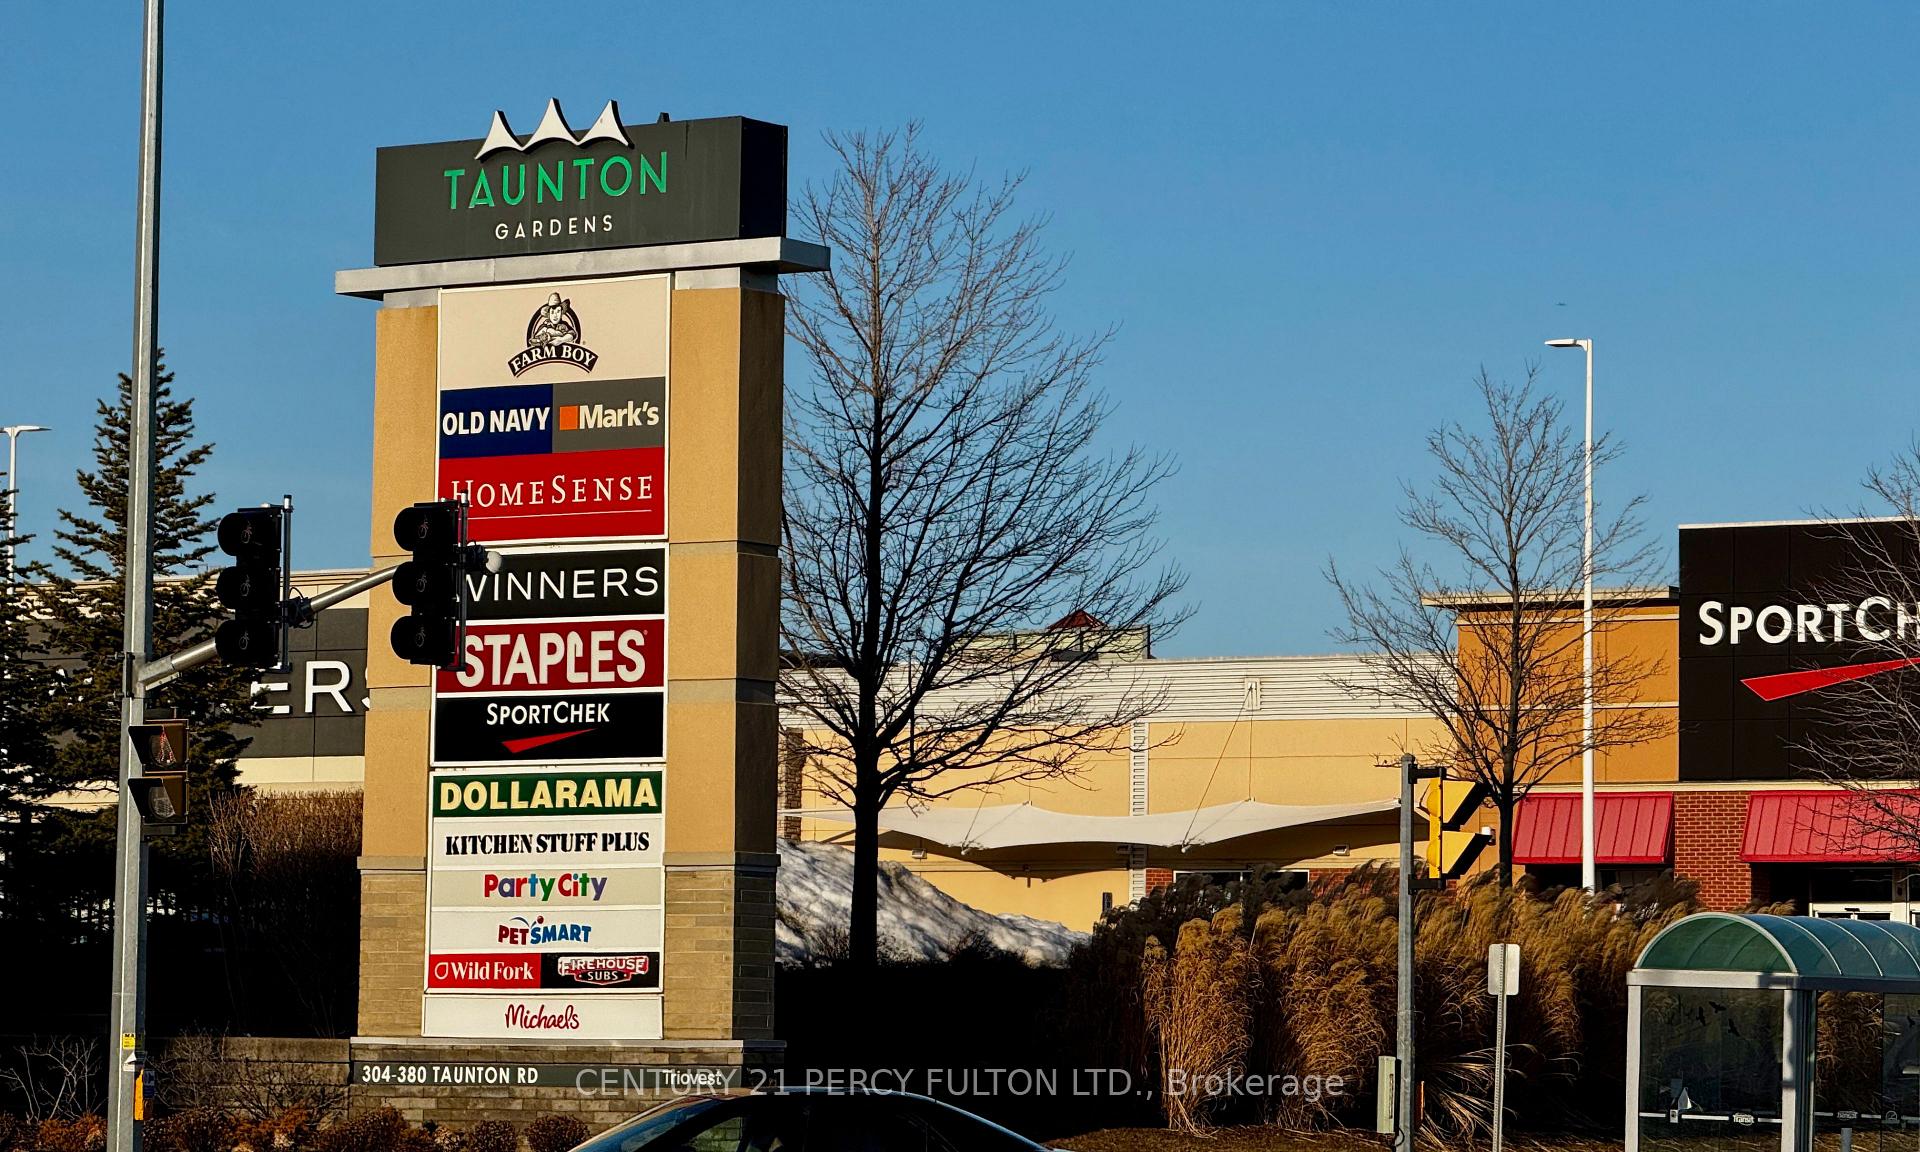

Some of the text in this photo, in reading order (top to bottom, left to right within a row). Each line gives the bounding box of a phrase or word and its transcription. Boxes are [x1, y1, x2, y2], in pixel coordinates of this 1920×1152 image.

[443, 151, 668, 210] TAUNTON
[495, 214, 613, 240] GARDENS
[511, 345, 596, 374] FARM BOY
[442, 406, 550, 436] OLD NAVY
[579, 400, 659, 430] Mark's
[451, 474, 653, 508] HOMESENSE
[456, 629, 646, 688] STAPLES
[486, 701, 611, 726] SPORTCHEK
[440, 778, 658, 811] DOLLARAMA
[445, 831, 650, 856] KITCHEN STUFF PLUS
[484, 872, 608, 902] Party City
[451, 961, 534, 981] Wild Fork
[561, 958, 646, 976] FIREHOUSE
[587, 971, 619, 981] SUBS
[505, 1003, 580, 1030] Michaels
[362, 1065, 539, 1084] 304-380 TAUNTON RD
[662, 1069, 722, 1086] Triovest
